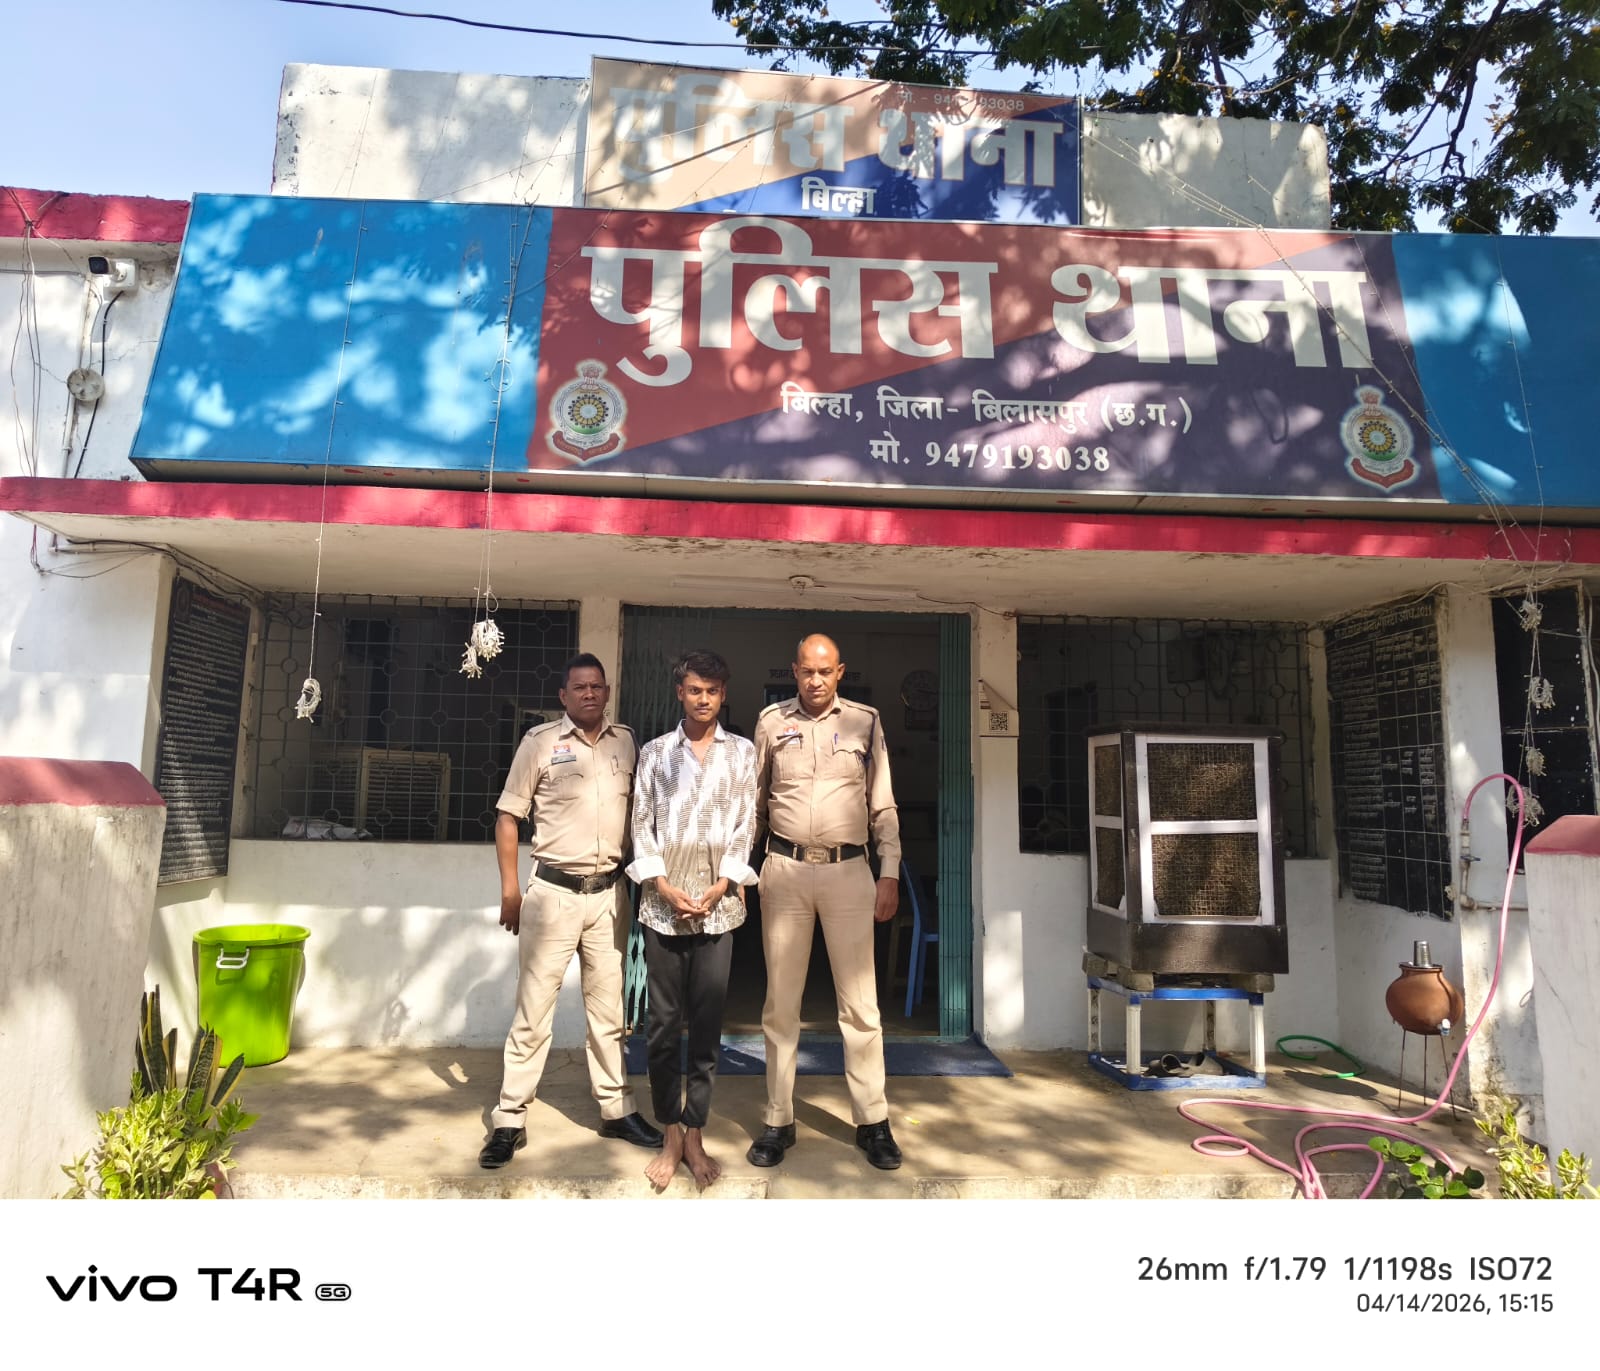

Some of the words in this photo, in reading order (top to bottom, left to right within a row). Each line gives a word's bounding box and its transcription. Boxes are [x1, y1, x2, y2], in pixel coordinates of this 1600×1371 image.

[610, 74, 854, 183] पुलिस
[879, 106, 1064, 187] थाना
[801, 176, 877, 216] बिल्हा
[581, 216, 998, 387] पुलिस
[1051, 263, 1373, 369] थाना
[781, 382, 864, 422] बिल्हा,
[876, 385, 959, 421] जिला-
[972, 389, 1088, 433] बिलासपुर
[1101, 395, 1193, 434] (छ.ग.)
[870, 431, 910, 465] मो.
[926, 441, 1111, 472] 9479193038
